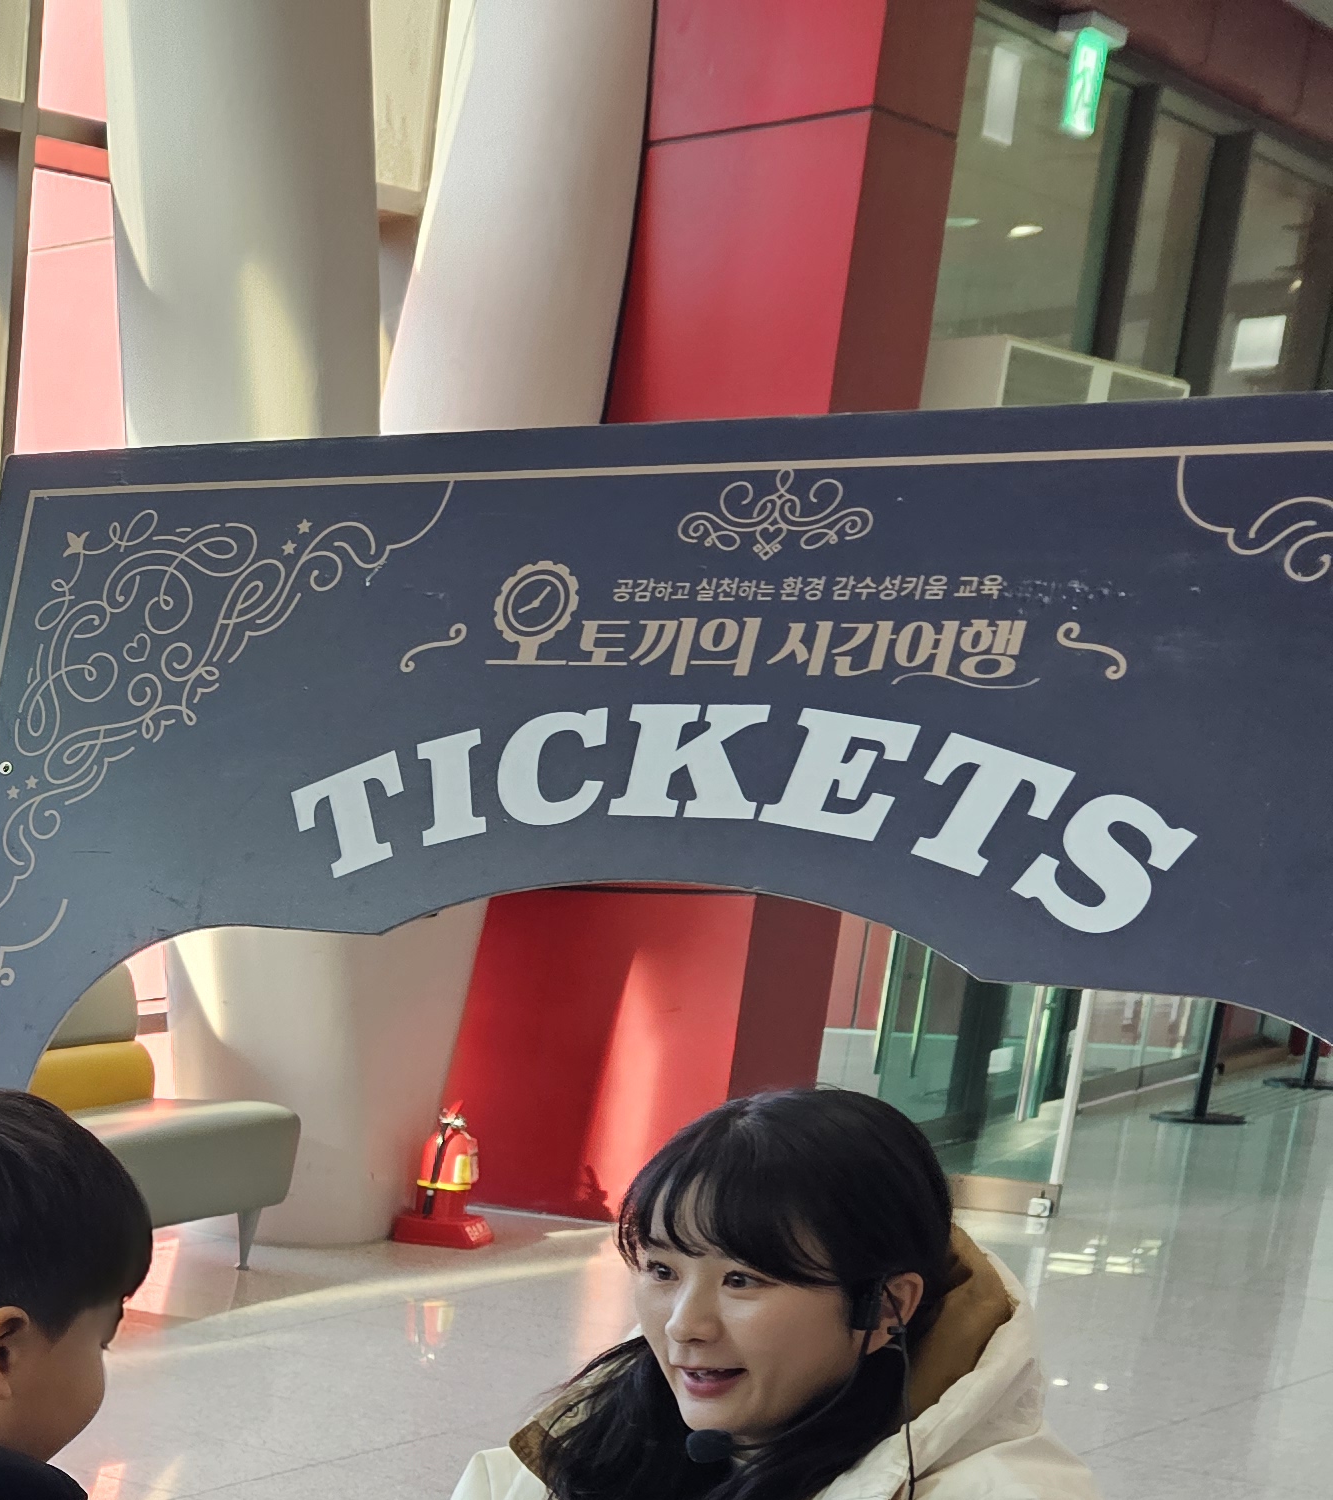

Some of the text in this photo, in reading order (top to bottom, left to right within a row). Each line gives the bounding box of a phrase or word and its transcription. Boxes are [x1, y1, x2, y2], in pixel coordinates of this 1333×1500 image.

[612, 574, 1004, 602] 공감하고 실천하는 환경 감수성키움 교육
[766, 619, 1030, 682] 시간여행
[290, 703, 1199, 934] TICKETS
